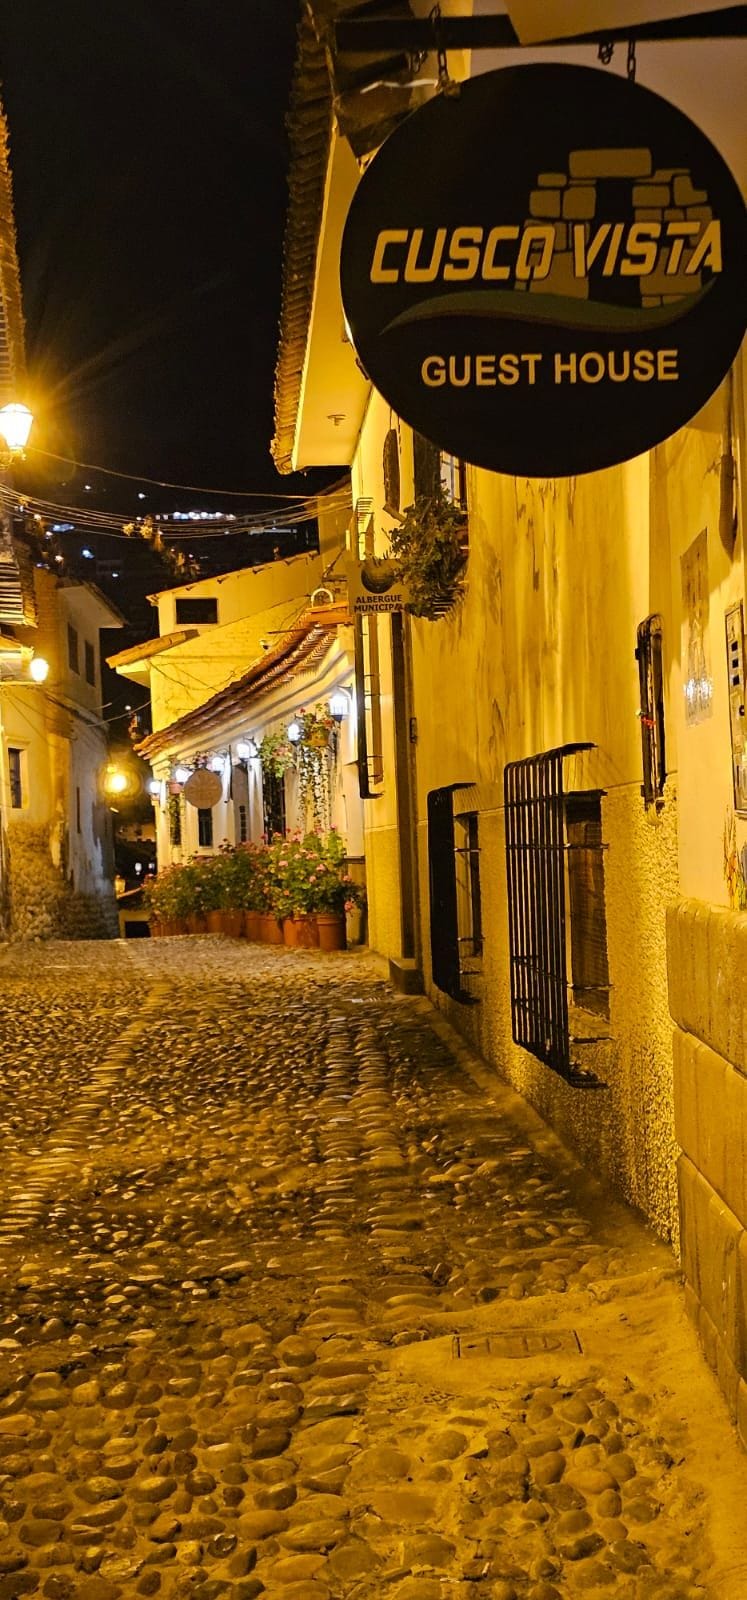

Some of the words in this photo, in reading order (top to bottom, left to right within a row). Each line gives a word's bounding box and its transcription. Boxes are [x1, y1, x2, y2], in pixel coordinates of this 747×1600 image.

[370, 225, 555, 283] CUSCO
[573, 220, 722, 278] VISTA
[421, 354, 542, 387] GUEST
[554, 350, 679, 384] HOUSE
[356, 595, 402, 604] ALBERGUE
